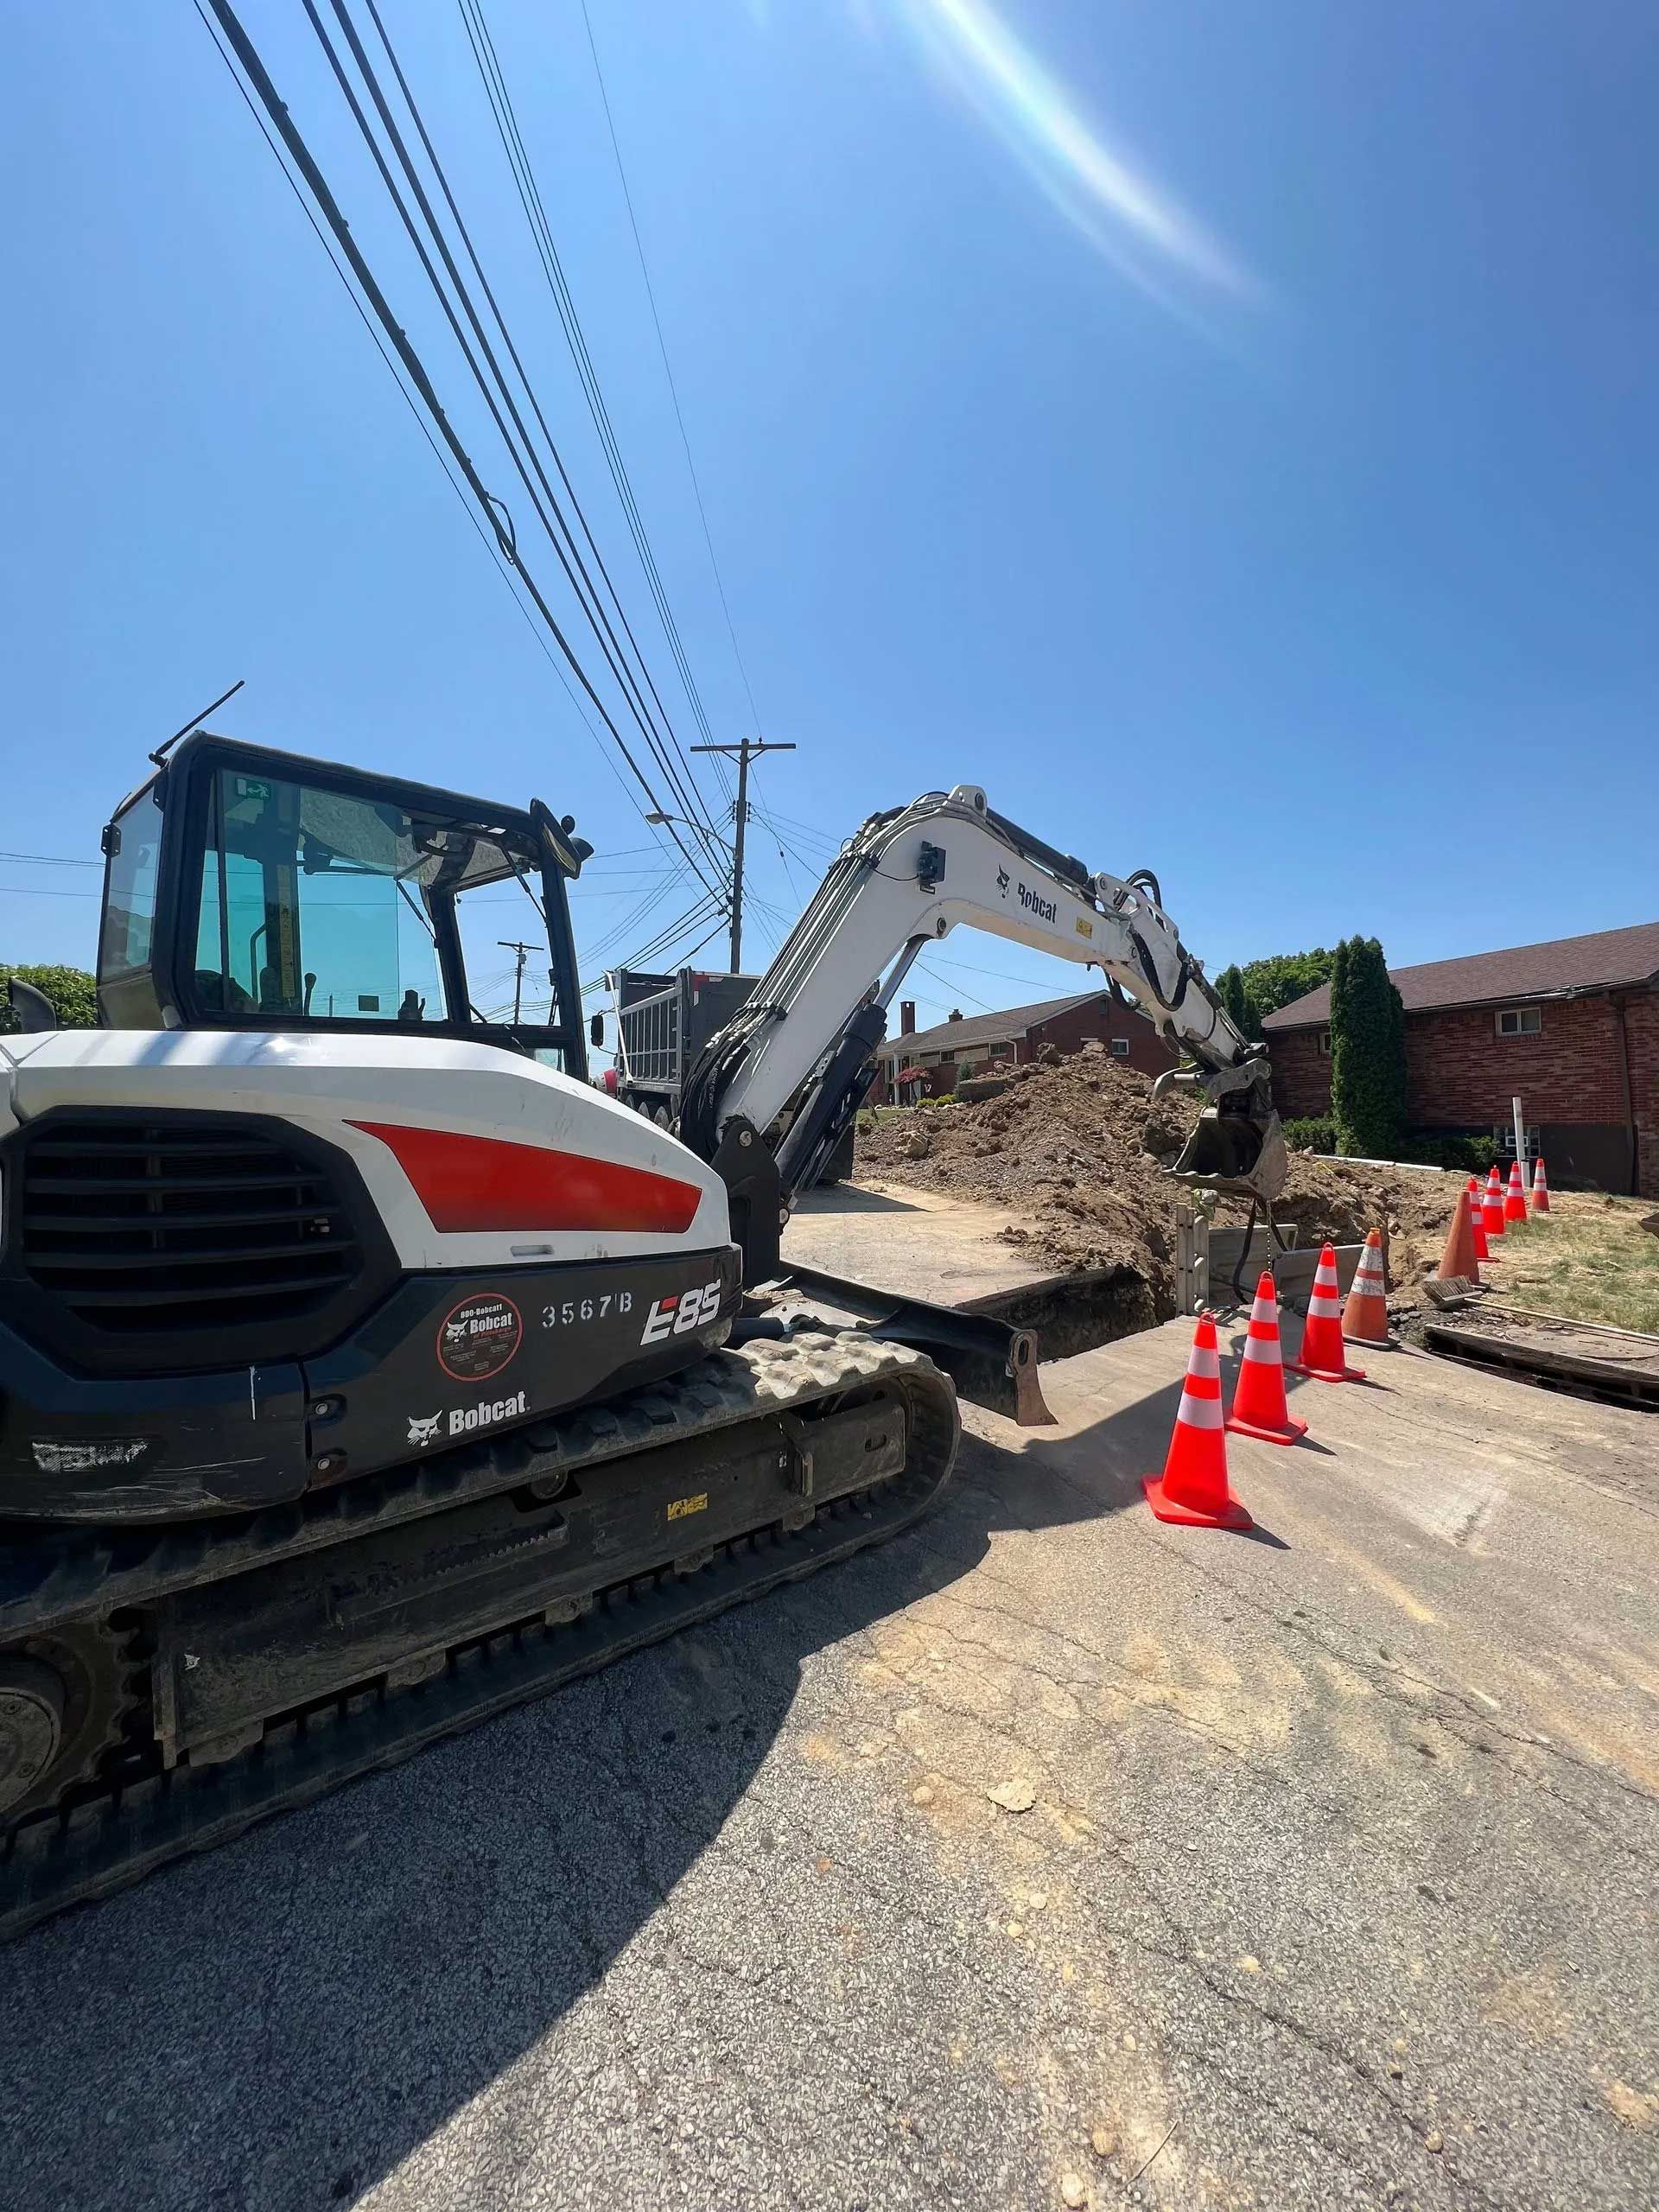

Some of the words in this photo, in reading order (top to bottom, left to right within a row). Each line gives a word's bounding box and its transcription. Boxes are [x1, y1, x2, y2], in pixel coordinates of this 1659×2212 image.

[470, 1313, 512, 1334] Bobcat
[640, 1279, 721, 1345] E85
[449, 1391, 525, 1435] Bobcat
